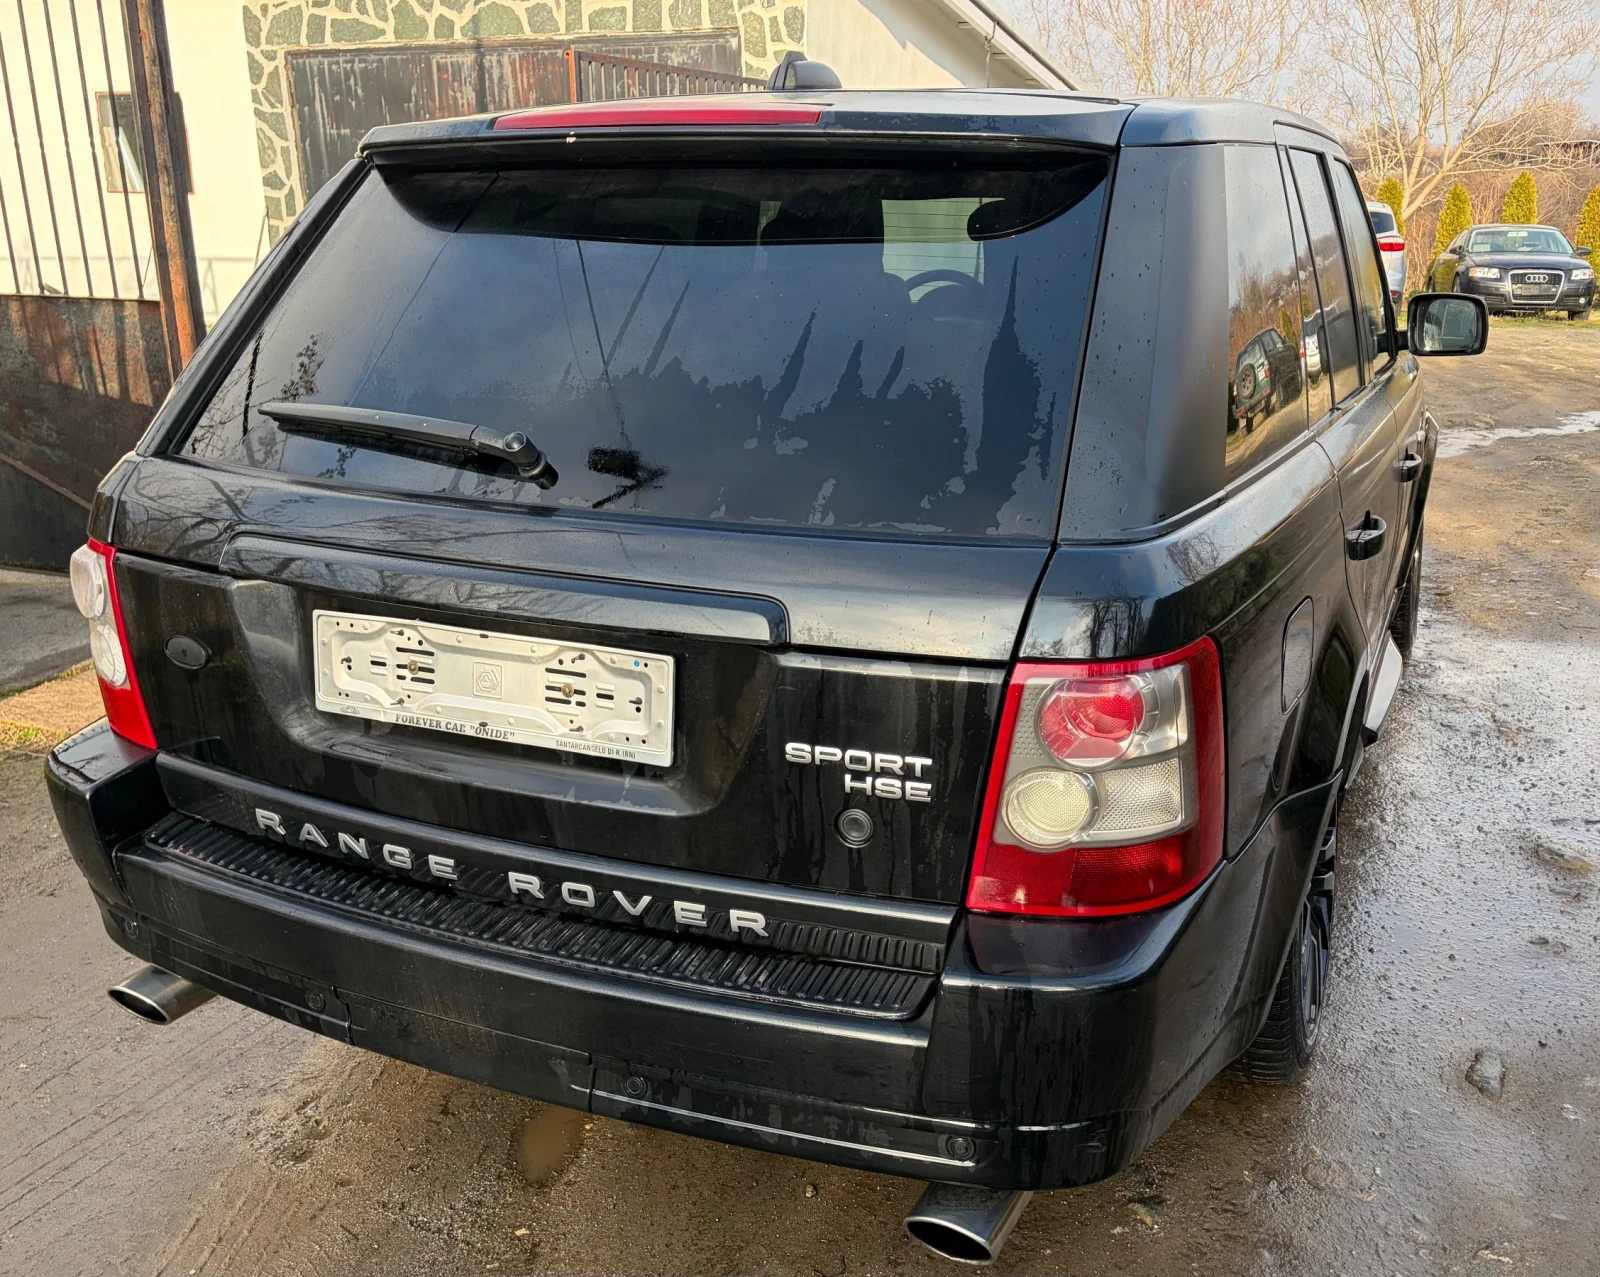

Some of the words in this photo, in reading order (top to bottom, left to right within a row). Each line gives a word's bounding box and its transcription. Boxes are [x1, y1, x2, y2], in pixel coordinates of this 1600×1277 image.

[395, 713, 442, 730] FOREVER
[622, 749, 636, 759] (RN)
[785, 742, 933, 778] SPORT
[844, 773, 932, 803] HSE
[254, 808, 460, 881] RANGE
[507, 870, 770, 937] ROVER
